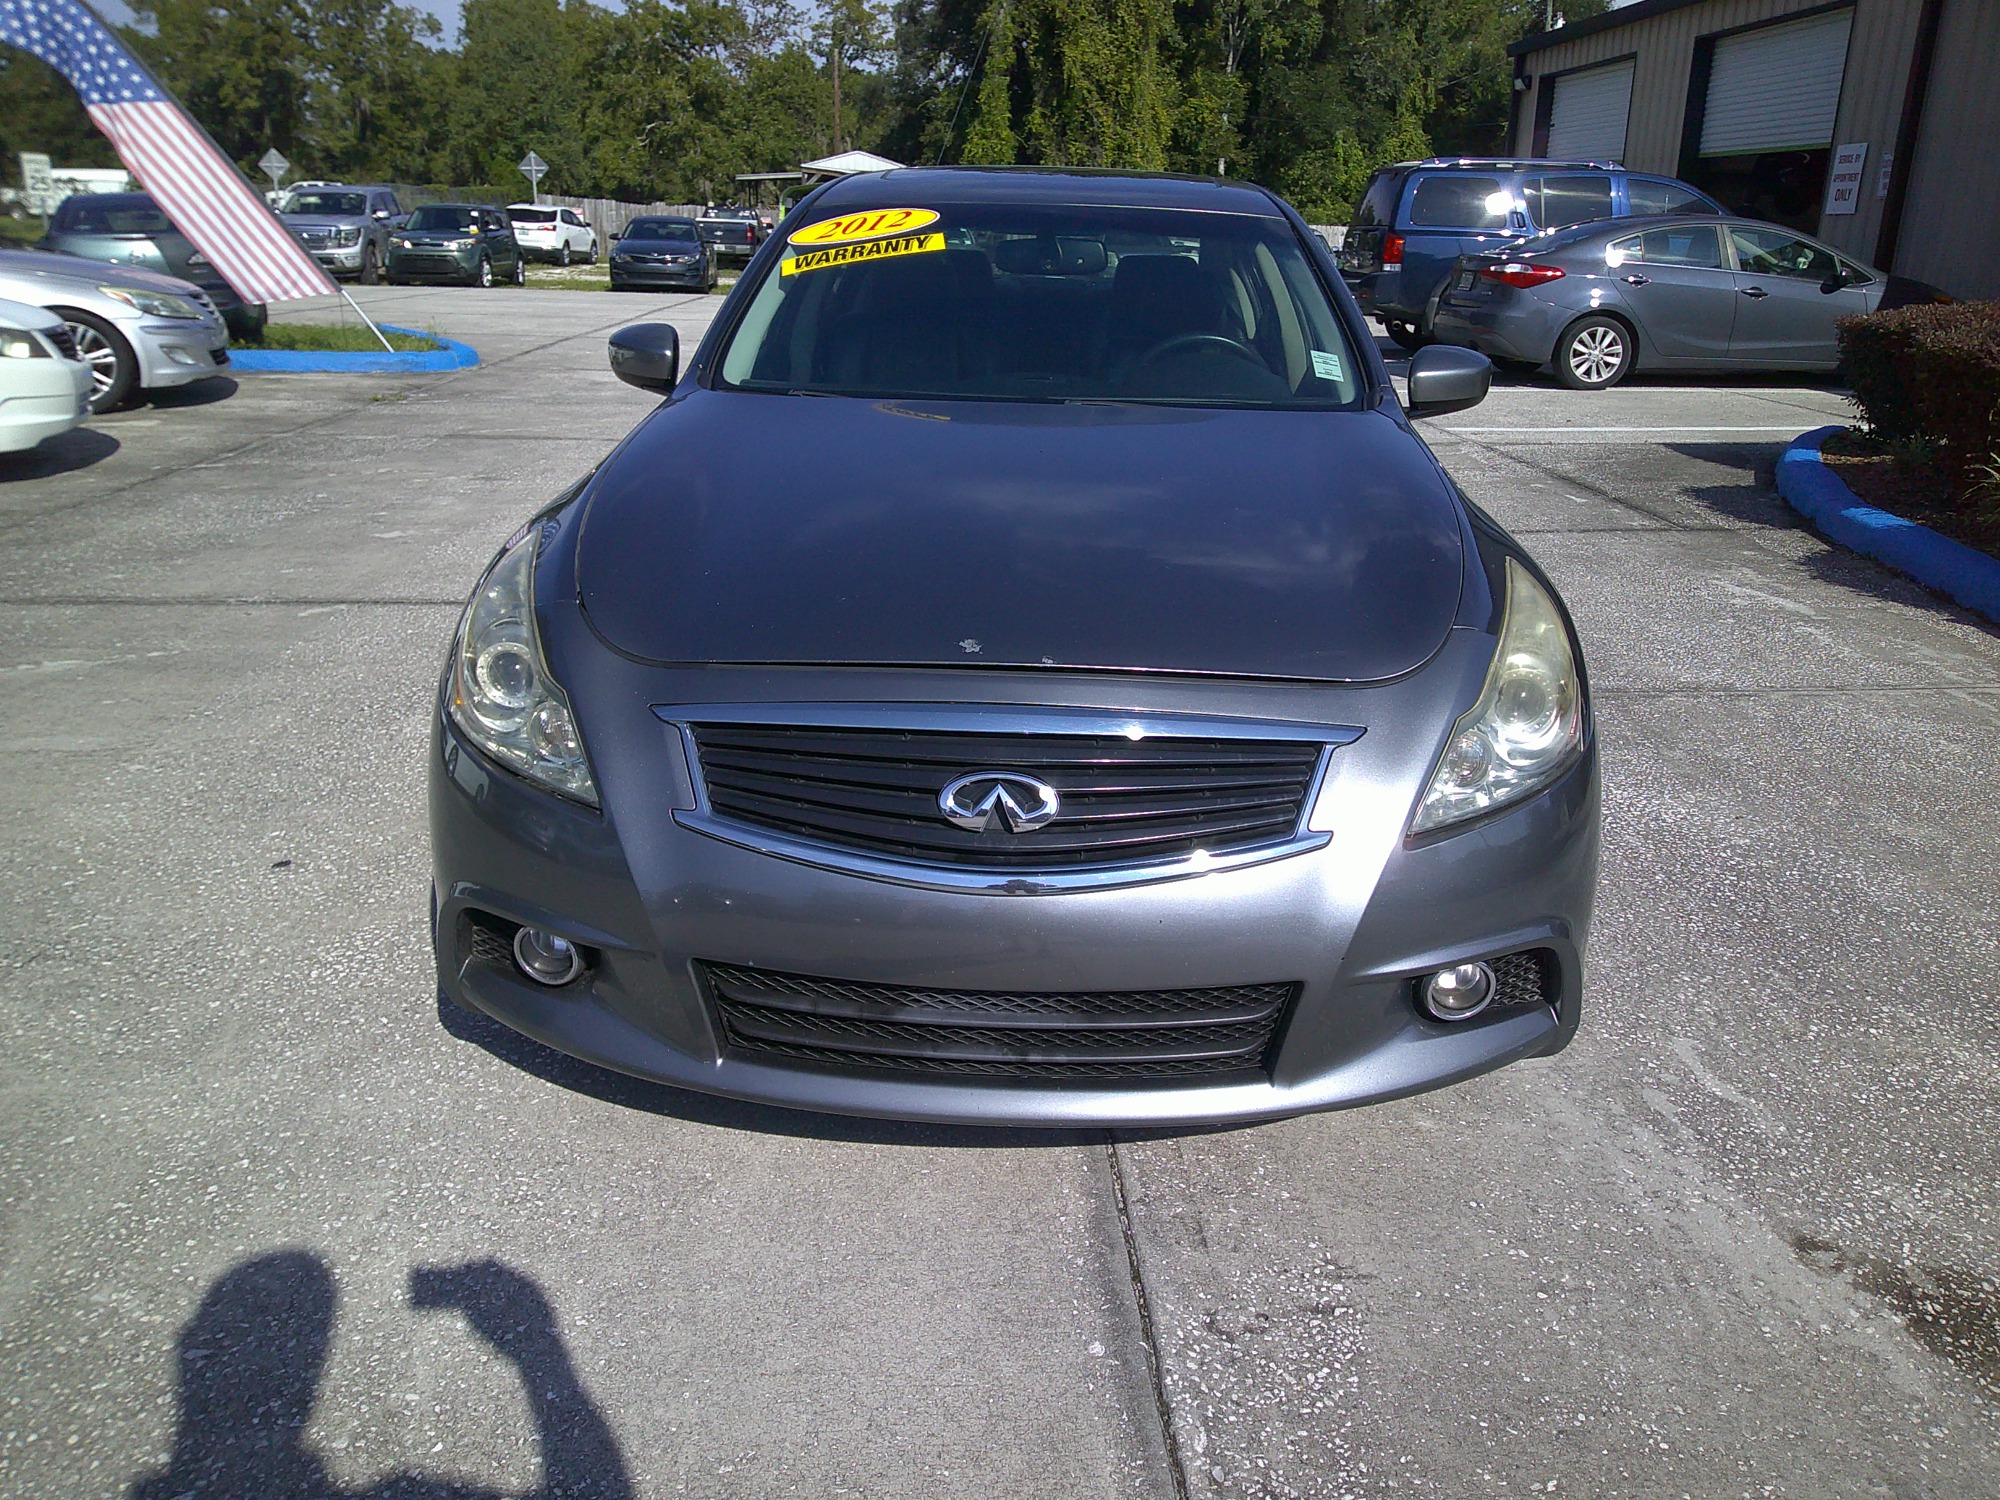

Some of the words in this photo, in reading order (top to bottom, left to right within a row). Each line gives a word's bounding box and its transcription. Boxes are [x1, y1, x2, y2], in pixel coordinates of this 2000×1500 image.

[1838, 154, 1855, 164] SERVICE
[30, 175, 49, 191] 25
[1834, 188, 1853, 202] ONLY
[815, 211, 912, 240] 2012
[794, 235, 933, 270] WARRANTY
